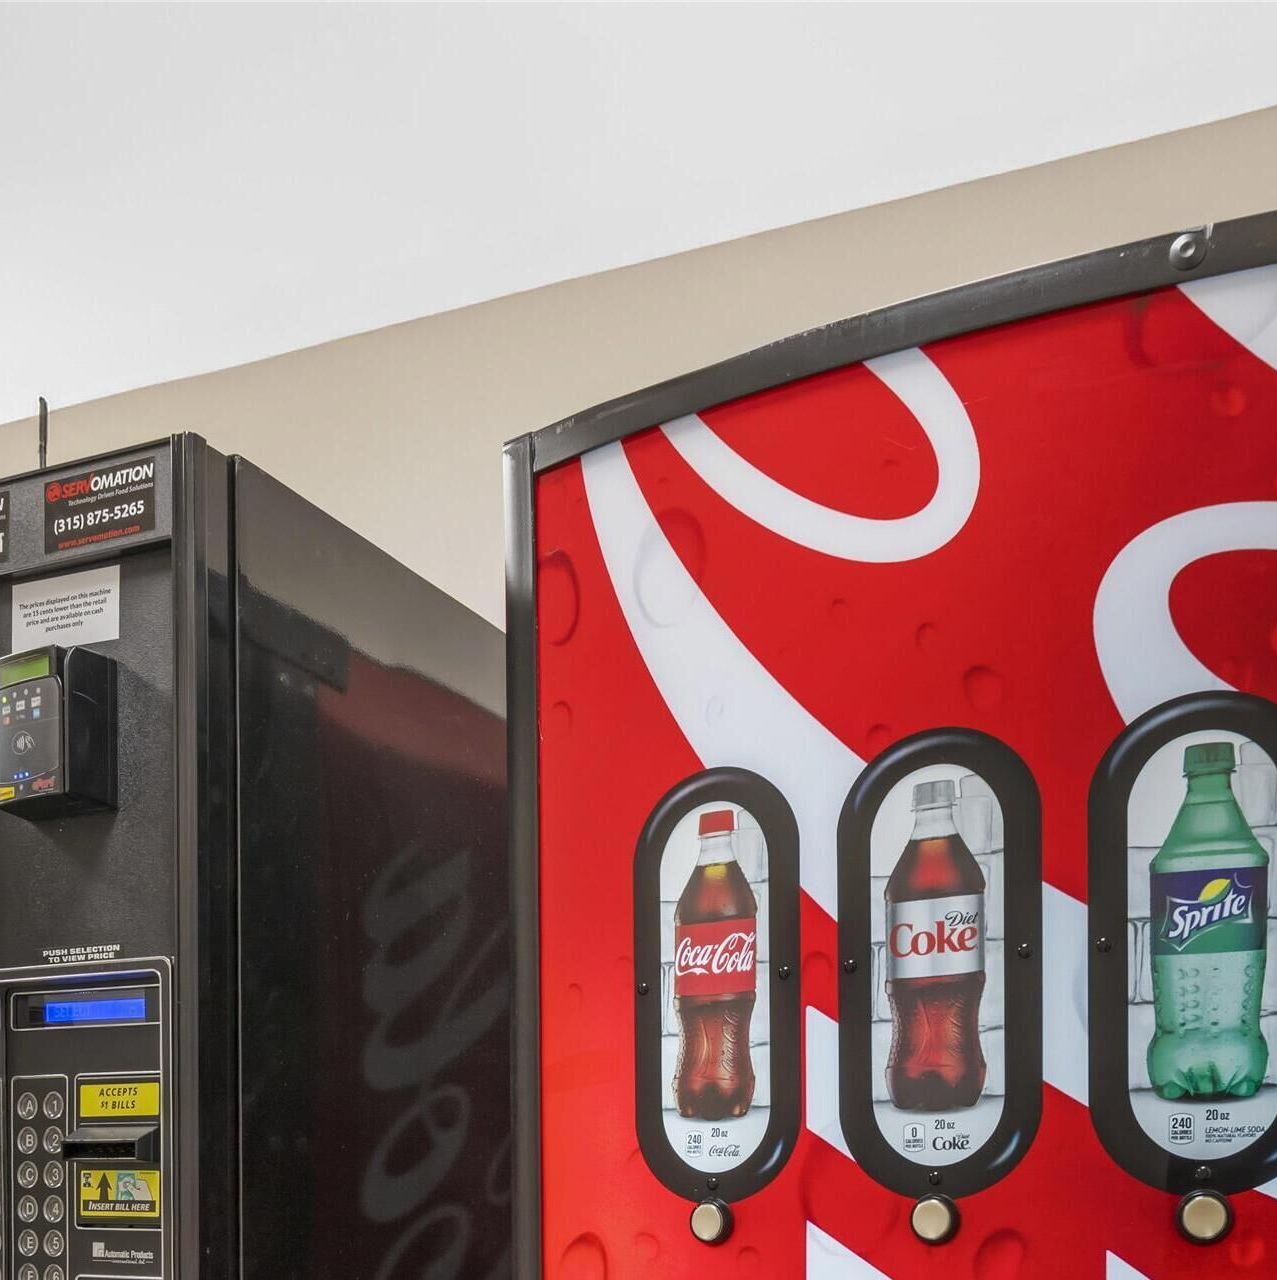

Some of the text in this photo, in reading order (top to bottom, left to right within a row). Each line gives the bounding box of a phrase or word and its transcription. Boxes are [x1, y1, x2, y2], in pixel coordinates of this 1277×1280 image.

[62, 463, 153, 498] SERVOMATION
[54, 500, 144, 535] (315) 875-5265
[944, 909, 978, 927] Diet
[1168, 891, 1246, 940] Sprite
[889, 923, 979, 959] Coke
[43, 944, 120, 956] PUSH SELECTION
[674, 931, 755, 977] Coca-Cola
[62, 954, 86, 962] VIEW
[99, 1088, 137, 1096] ACCEPTS
[101, 1100, 136, 1109] $1 BILLS
[1206, 1109, 1218, 1120] 20
[935, 1119, 945, 1129] 20
[1172, 1117, 1192, 1129] 240
[912, 1127, 917, 1137] 0
[688, 1135, 702, 1144] 240
[932, 1136, 971, 1151] Coke
[88, 1201, 150, 1211] INSERT BILL HERE
[105, 1250, 153, 1259] Automatic Products
